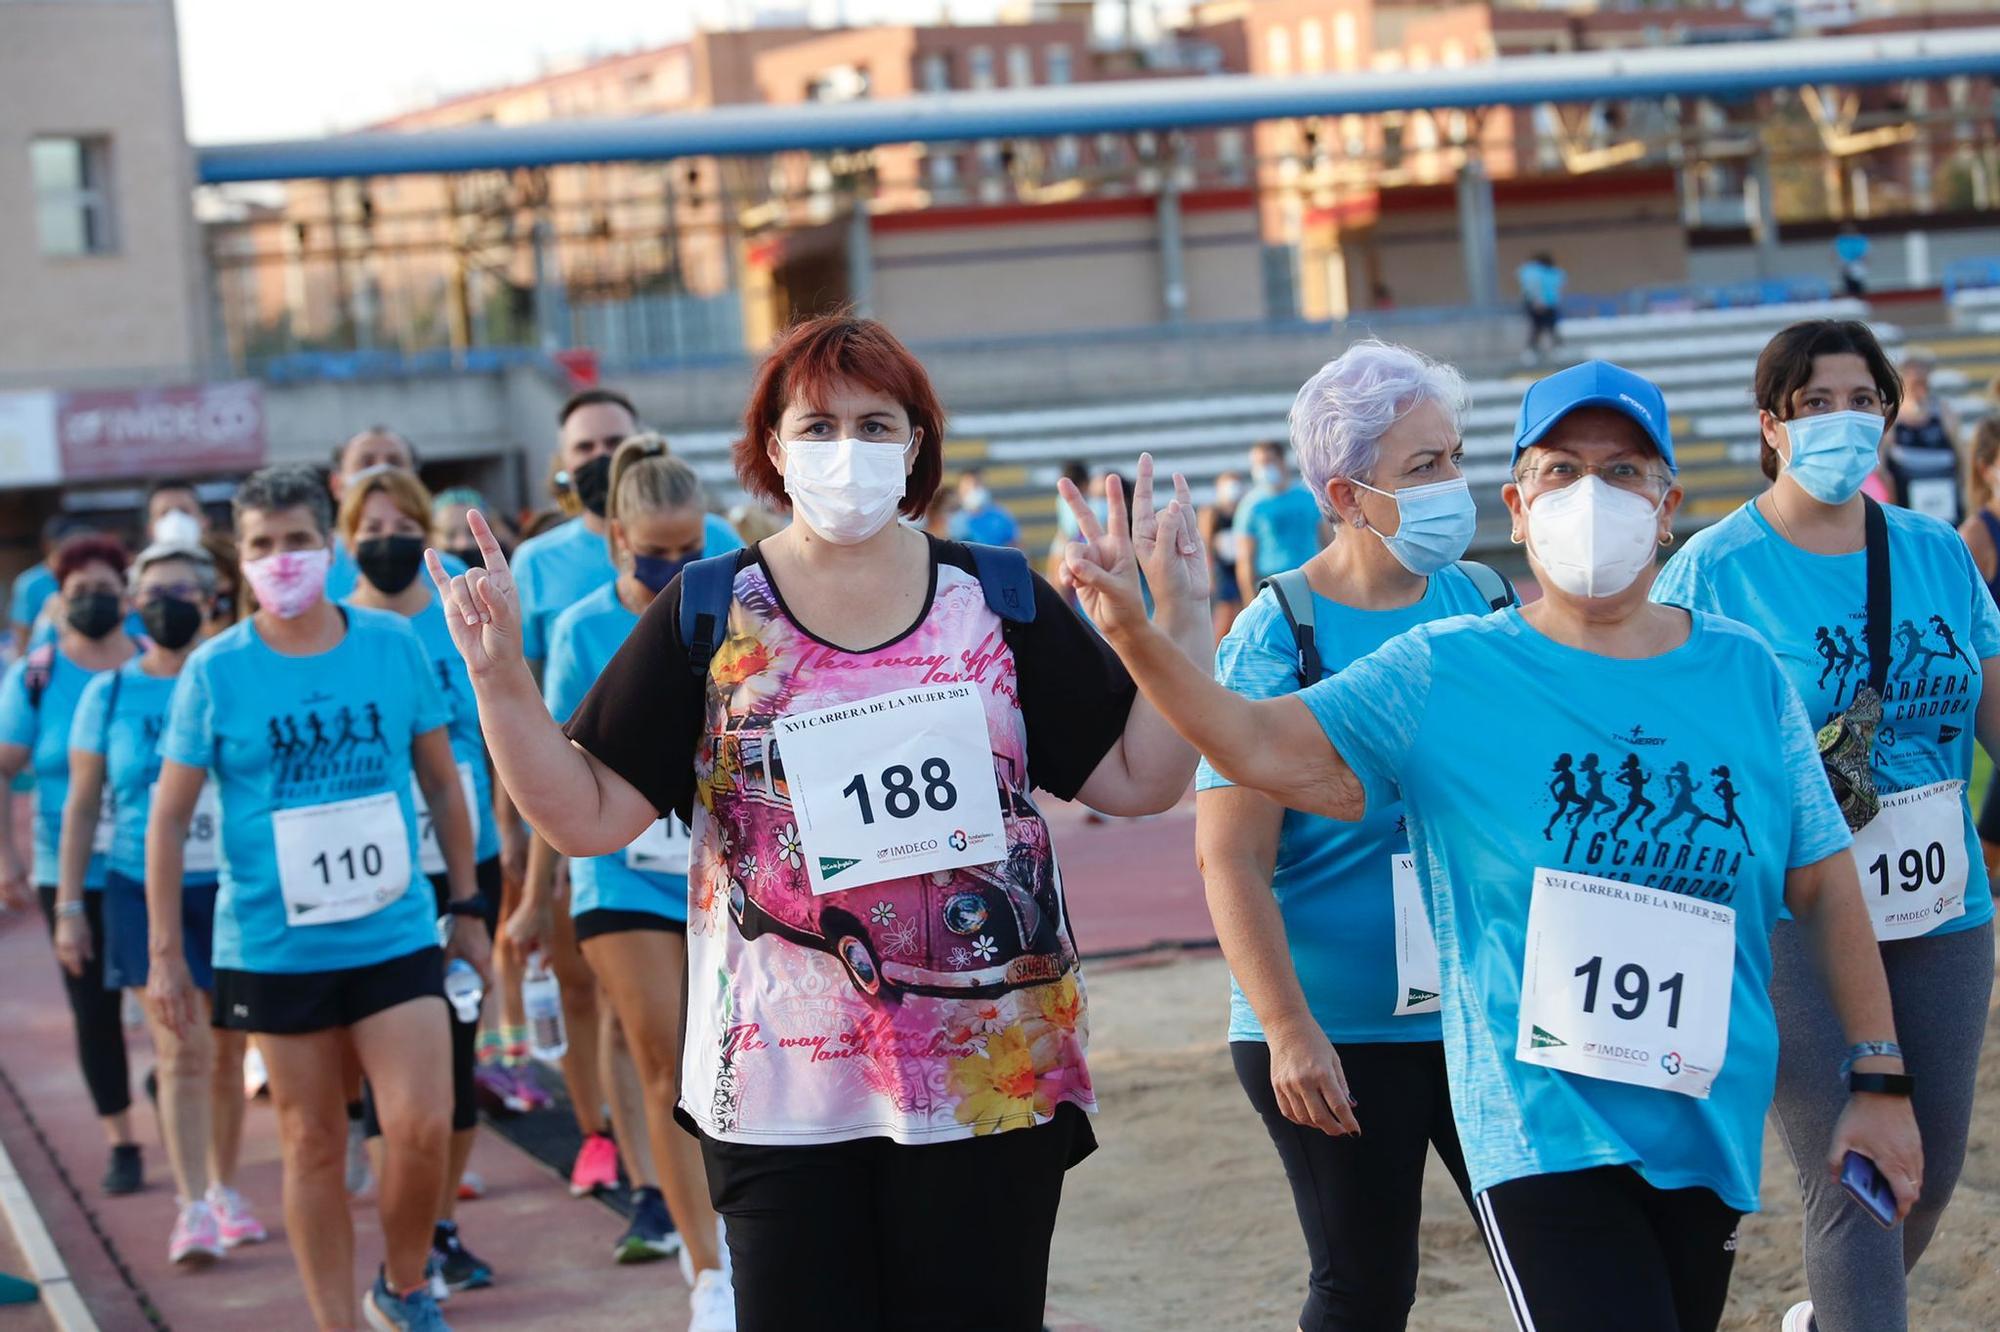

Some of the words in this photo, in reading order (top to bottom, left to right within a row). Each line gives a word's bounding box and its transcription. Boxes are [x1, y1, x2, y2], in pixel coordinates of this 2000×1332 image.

[1881, 674, 1969, 702] ARRERA
[785, 719, 808, 733] XVI
[808, 706, 868, 728] CARRERA
[870, 702, 886, 714] DE
[889, 698, 905, 710] LA
[908, 691, 946, 706] MUJER
[948, 687, 970, 700] 2021
[843, 757, 957, 825] 188
[312, 844, 382, 885] 110
[891, 839, 938, 857] IMDECO
[1611, 838, 1742, 878] CARRERA
[1869, 841, 1945, 896] 190
[1545, 876, 1567, 888] XVI
[1570, 881, 1631, 901] CARRERA
[1634, 892, 1649, 905] DE
[1653, 896, 1669, 909] LA
[1672, 901, 1710, 918] MUJER
[1896, 908, 1930, 922] IMDECO
[1574, 955, 1687, 1029] 191
[779, 1034, 829, 1062] way
[1597, 1043, 1650, 1062] IMDECO
